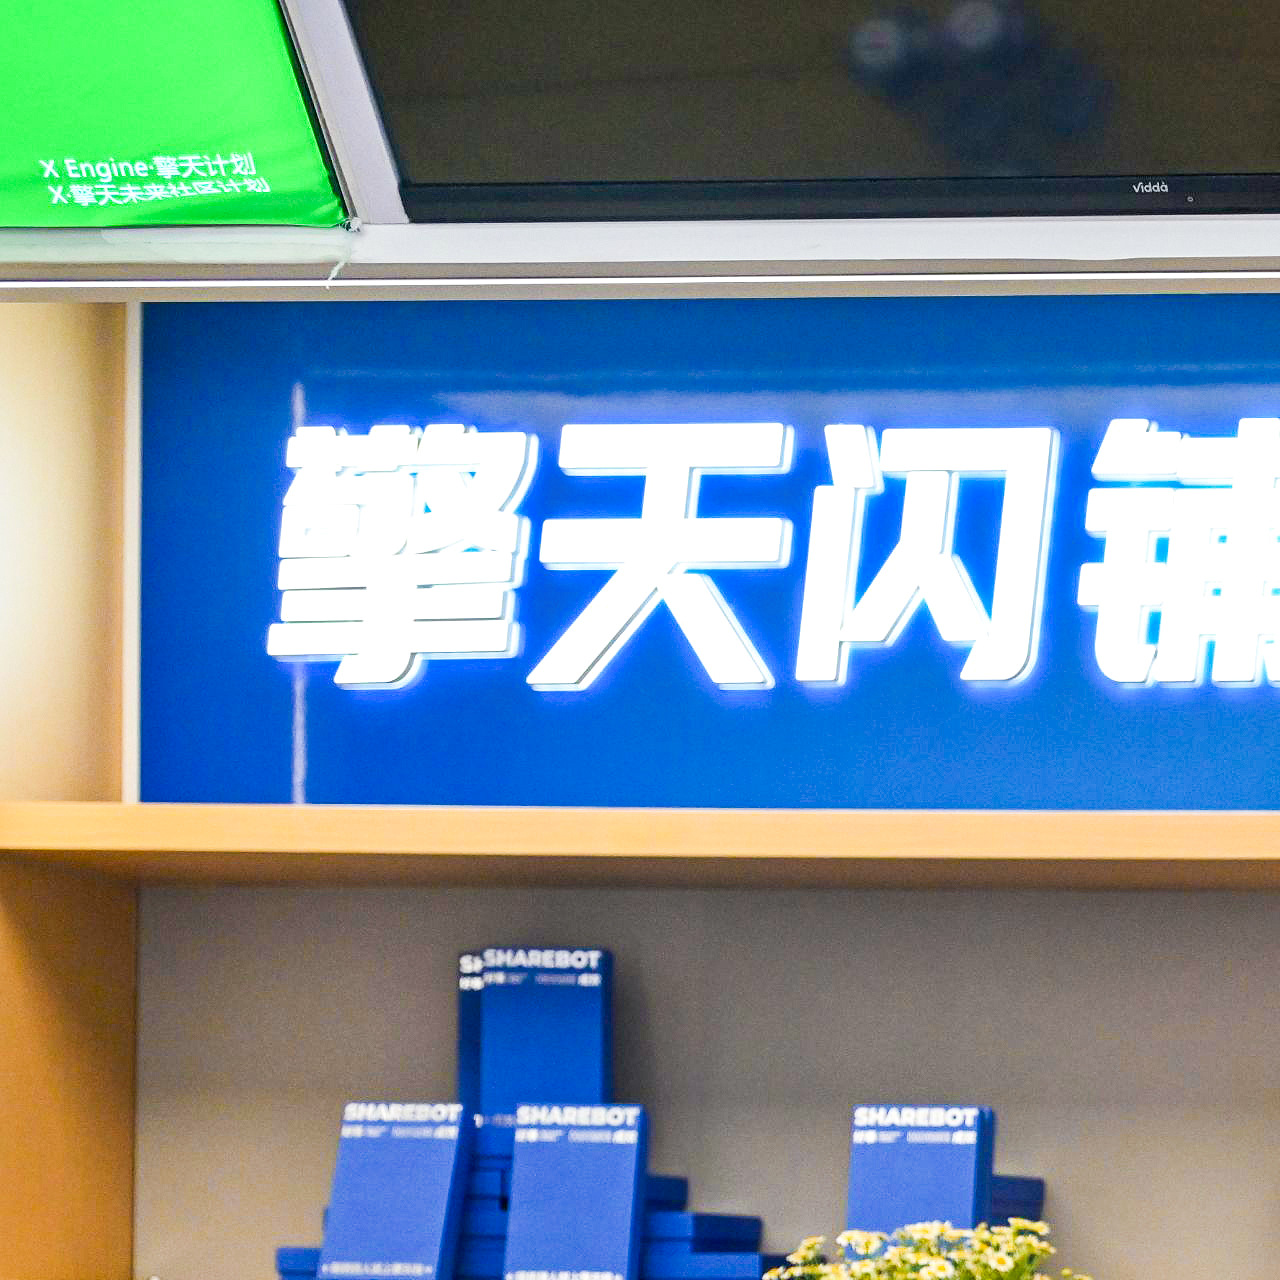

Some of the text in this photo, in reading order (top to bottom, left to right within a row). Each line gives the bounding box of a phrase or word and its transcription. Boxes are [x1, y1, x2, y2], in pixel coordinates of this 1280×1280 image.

[39, 159, 60, 178] X
[483, 948, 601, 969] SHAREBOT
[344, 1102, 463, 1122] SHAREBOT
[516, 1105, 640, 1126] SHAREBOT
[854, 1107, 979, 1127] SHAREBOT
